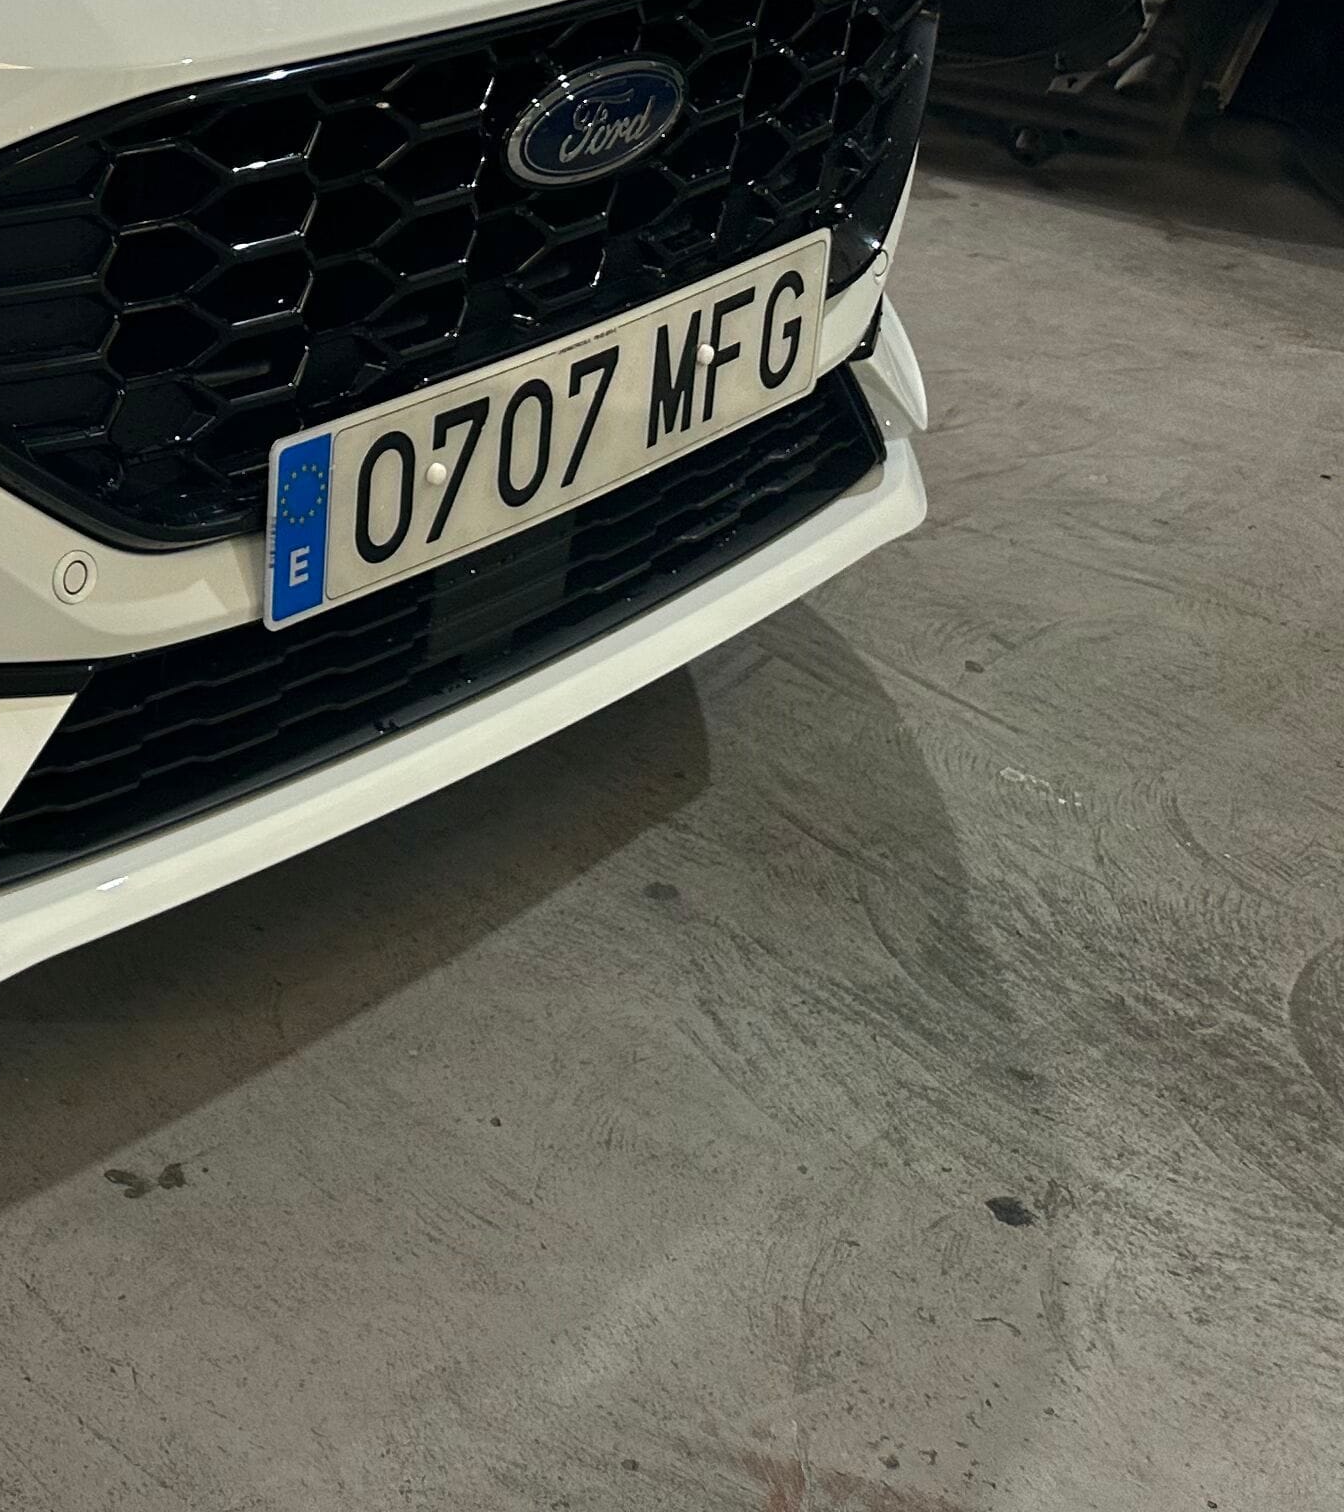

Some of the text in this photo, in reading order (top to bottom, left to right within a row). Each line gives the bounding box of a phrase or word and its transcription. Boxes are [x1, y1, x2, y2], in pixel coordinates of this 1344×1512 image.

[559, 88, 656, 163] Ford
[354, 270, 804, 564] 0707 MFG
[289, 545, 311, 587] E
